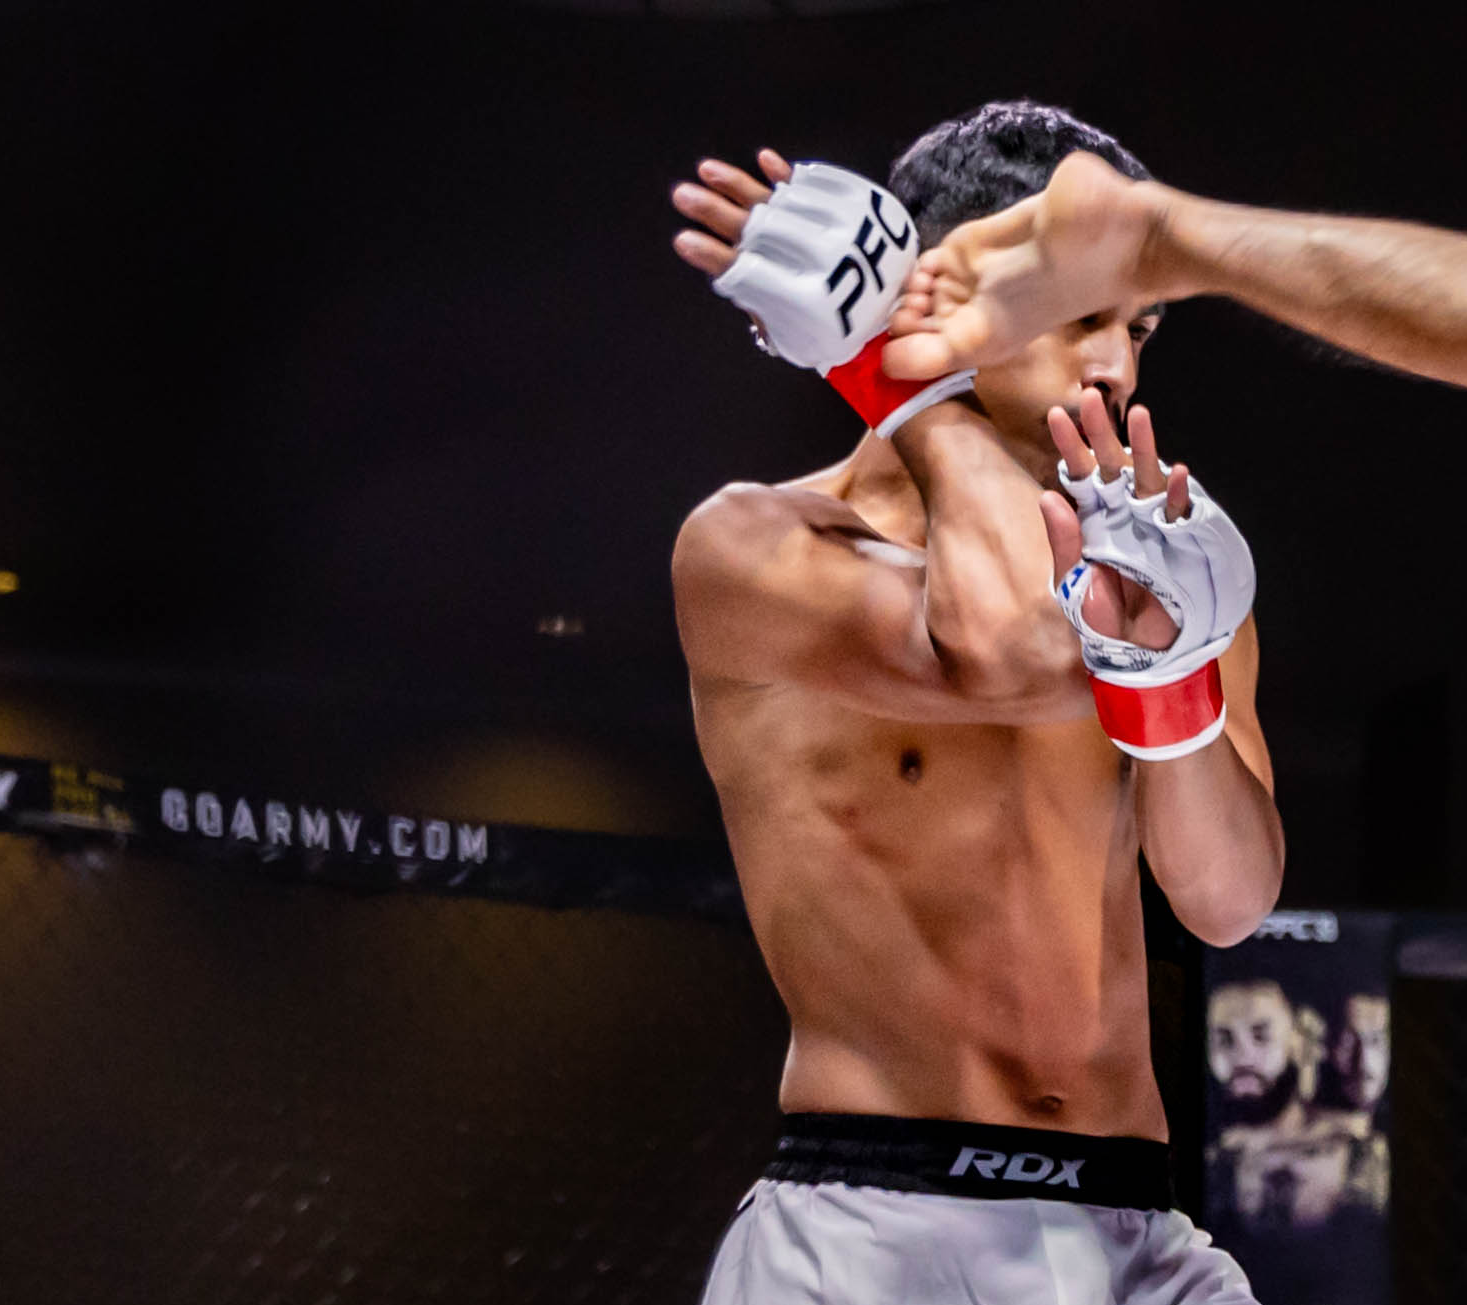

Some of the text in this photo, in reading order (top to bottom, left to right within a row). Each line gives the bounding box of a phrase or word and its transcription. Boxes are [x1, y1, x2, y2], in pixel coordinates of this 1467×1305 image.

[824, 189, 915, 338] PFC
[159, 786, 491, 866] GOARMY.COM
[948, 1146, 1087, 1189] RDX
